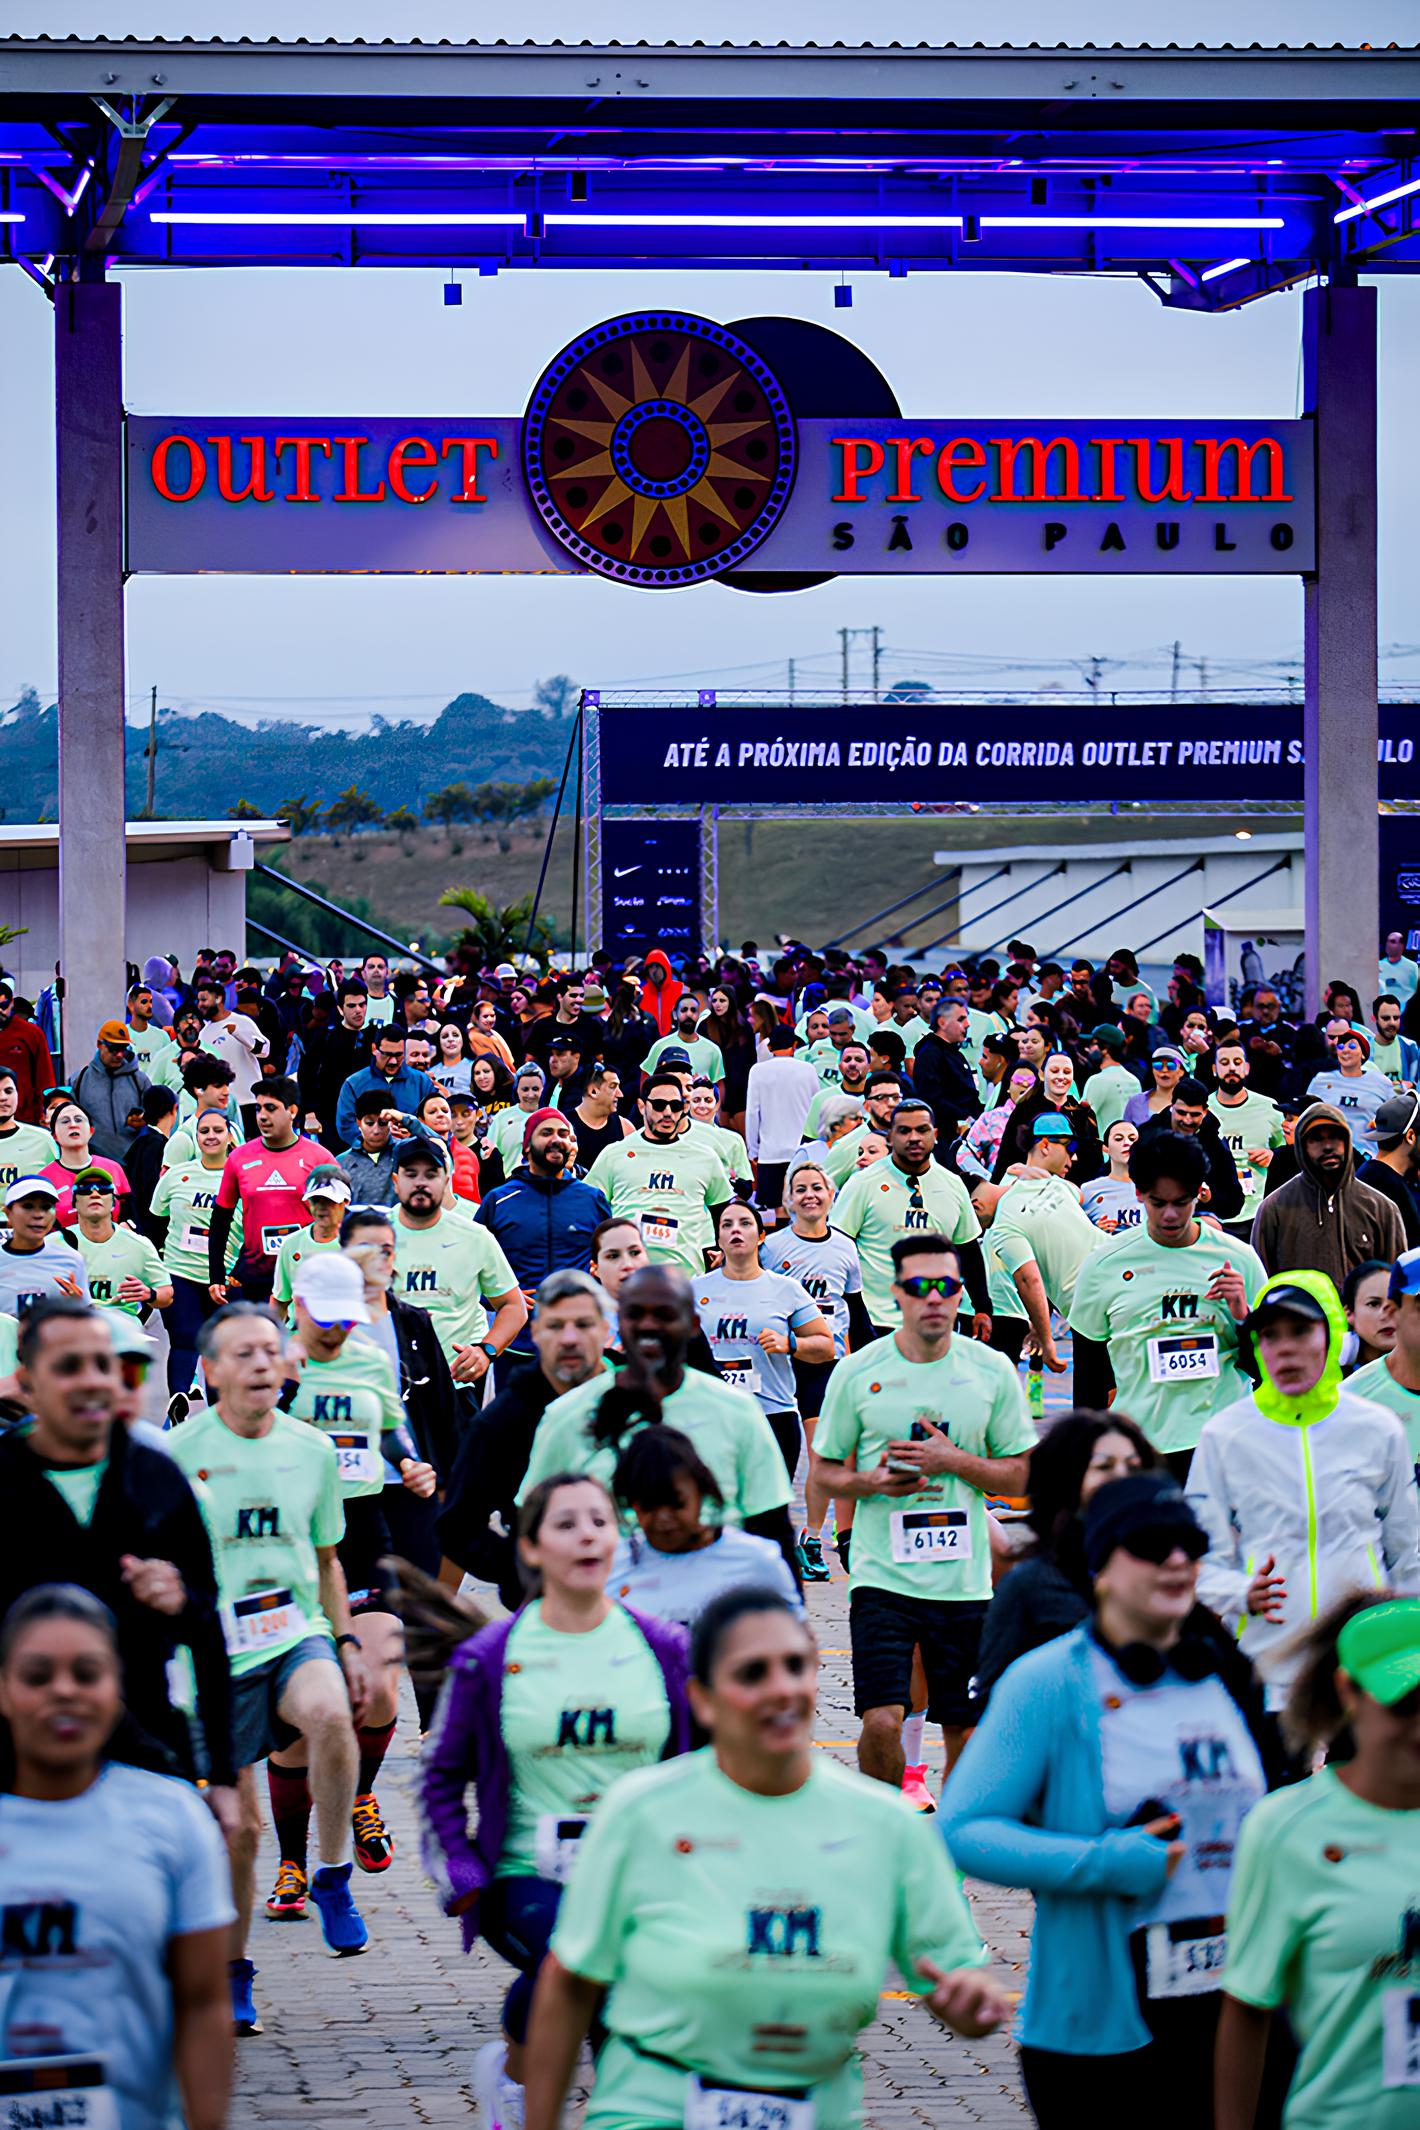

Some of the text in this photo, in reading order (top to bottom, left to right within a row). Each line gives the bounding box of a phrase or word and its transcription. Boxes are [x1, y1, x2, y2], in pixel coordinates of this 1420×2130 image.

[832, 515, 1294, 552] SÃO PAULO
[663, 737, 710, 767] ATÉ
[714, 743, 730, 767] A
[738, 736, 841, 767] PRÓXIMA
[847, 736, 933, 772] EDIÇÃO
[937, 742, 968, 767] DA
[975, 742, 1074, 767] CORRIDA
[1081, 742, 1173, 766] OUTLET
[1177, 740, 1282, 766] PREMIUM
[648, 1173, 674, 1189] KM
[905, 1210, 929, 1229] KM
[1117, 1209, 1142, 1225] KM
[406, 1271, 438, 1292] KM
[1161, 1295, 1199, 1319] KM
[717, 1318, 749, 1340] KM
[1168, 1352, 1207, 1370] 6054
[313, 1395, 353, 1421] KM
[237, 1507, 280, 1538] KM
[914, 1529, 958, 1549] 6142
[557, 1708, 617, 1746] KM
[748, 1905, 822, 1957] KM
